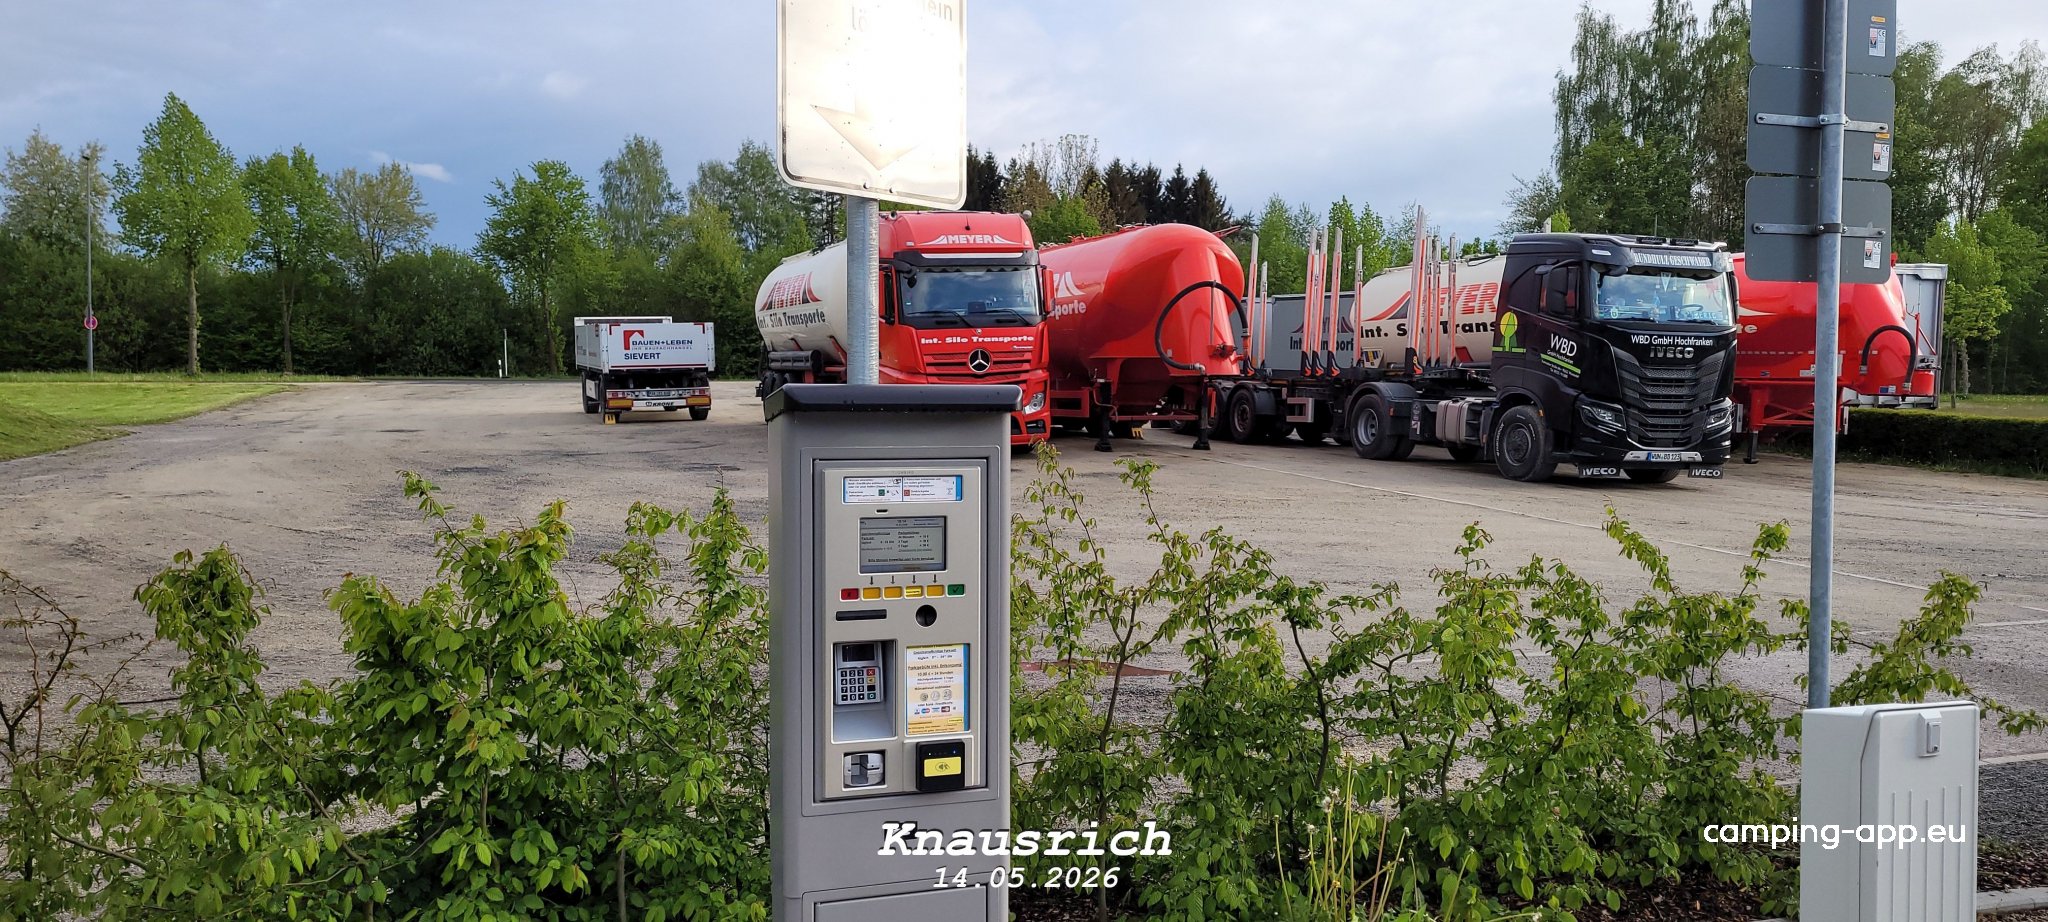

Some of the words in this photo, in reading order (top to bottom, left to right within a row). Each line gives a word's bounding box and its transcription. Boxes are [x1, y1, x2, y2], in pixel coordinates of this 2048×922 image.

[948, 235, 991, 244] MEYER
[1669, 254, 1712, 267] GESCHWADER
[770, 312, 782, 328] Silo
[783, 308, 826, 328] Transporte
[1361, 325, 1389, 339] Int.
[921, 337, 942, 345] Int.
[971, 335, 1034, 343] Transporte
[1550, 333, 1577, 356] WBD
[1631, 334, 1651, 344] WBD
[1651, 335, 1674, 345] GmbH
[1674, 336, 1713, 346] Hochfranken
[624, 352, 661, 360] SIEVERT
[1649, 346, 1695, 359] IVECO
[1583, 467, 1617, 476] IVECO
[1691, 468, 1720, 477] IVECO
